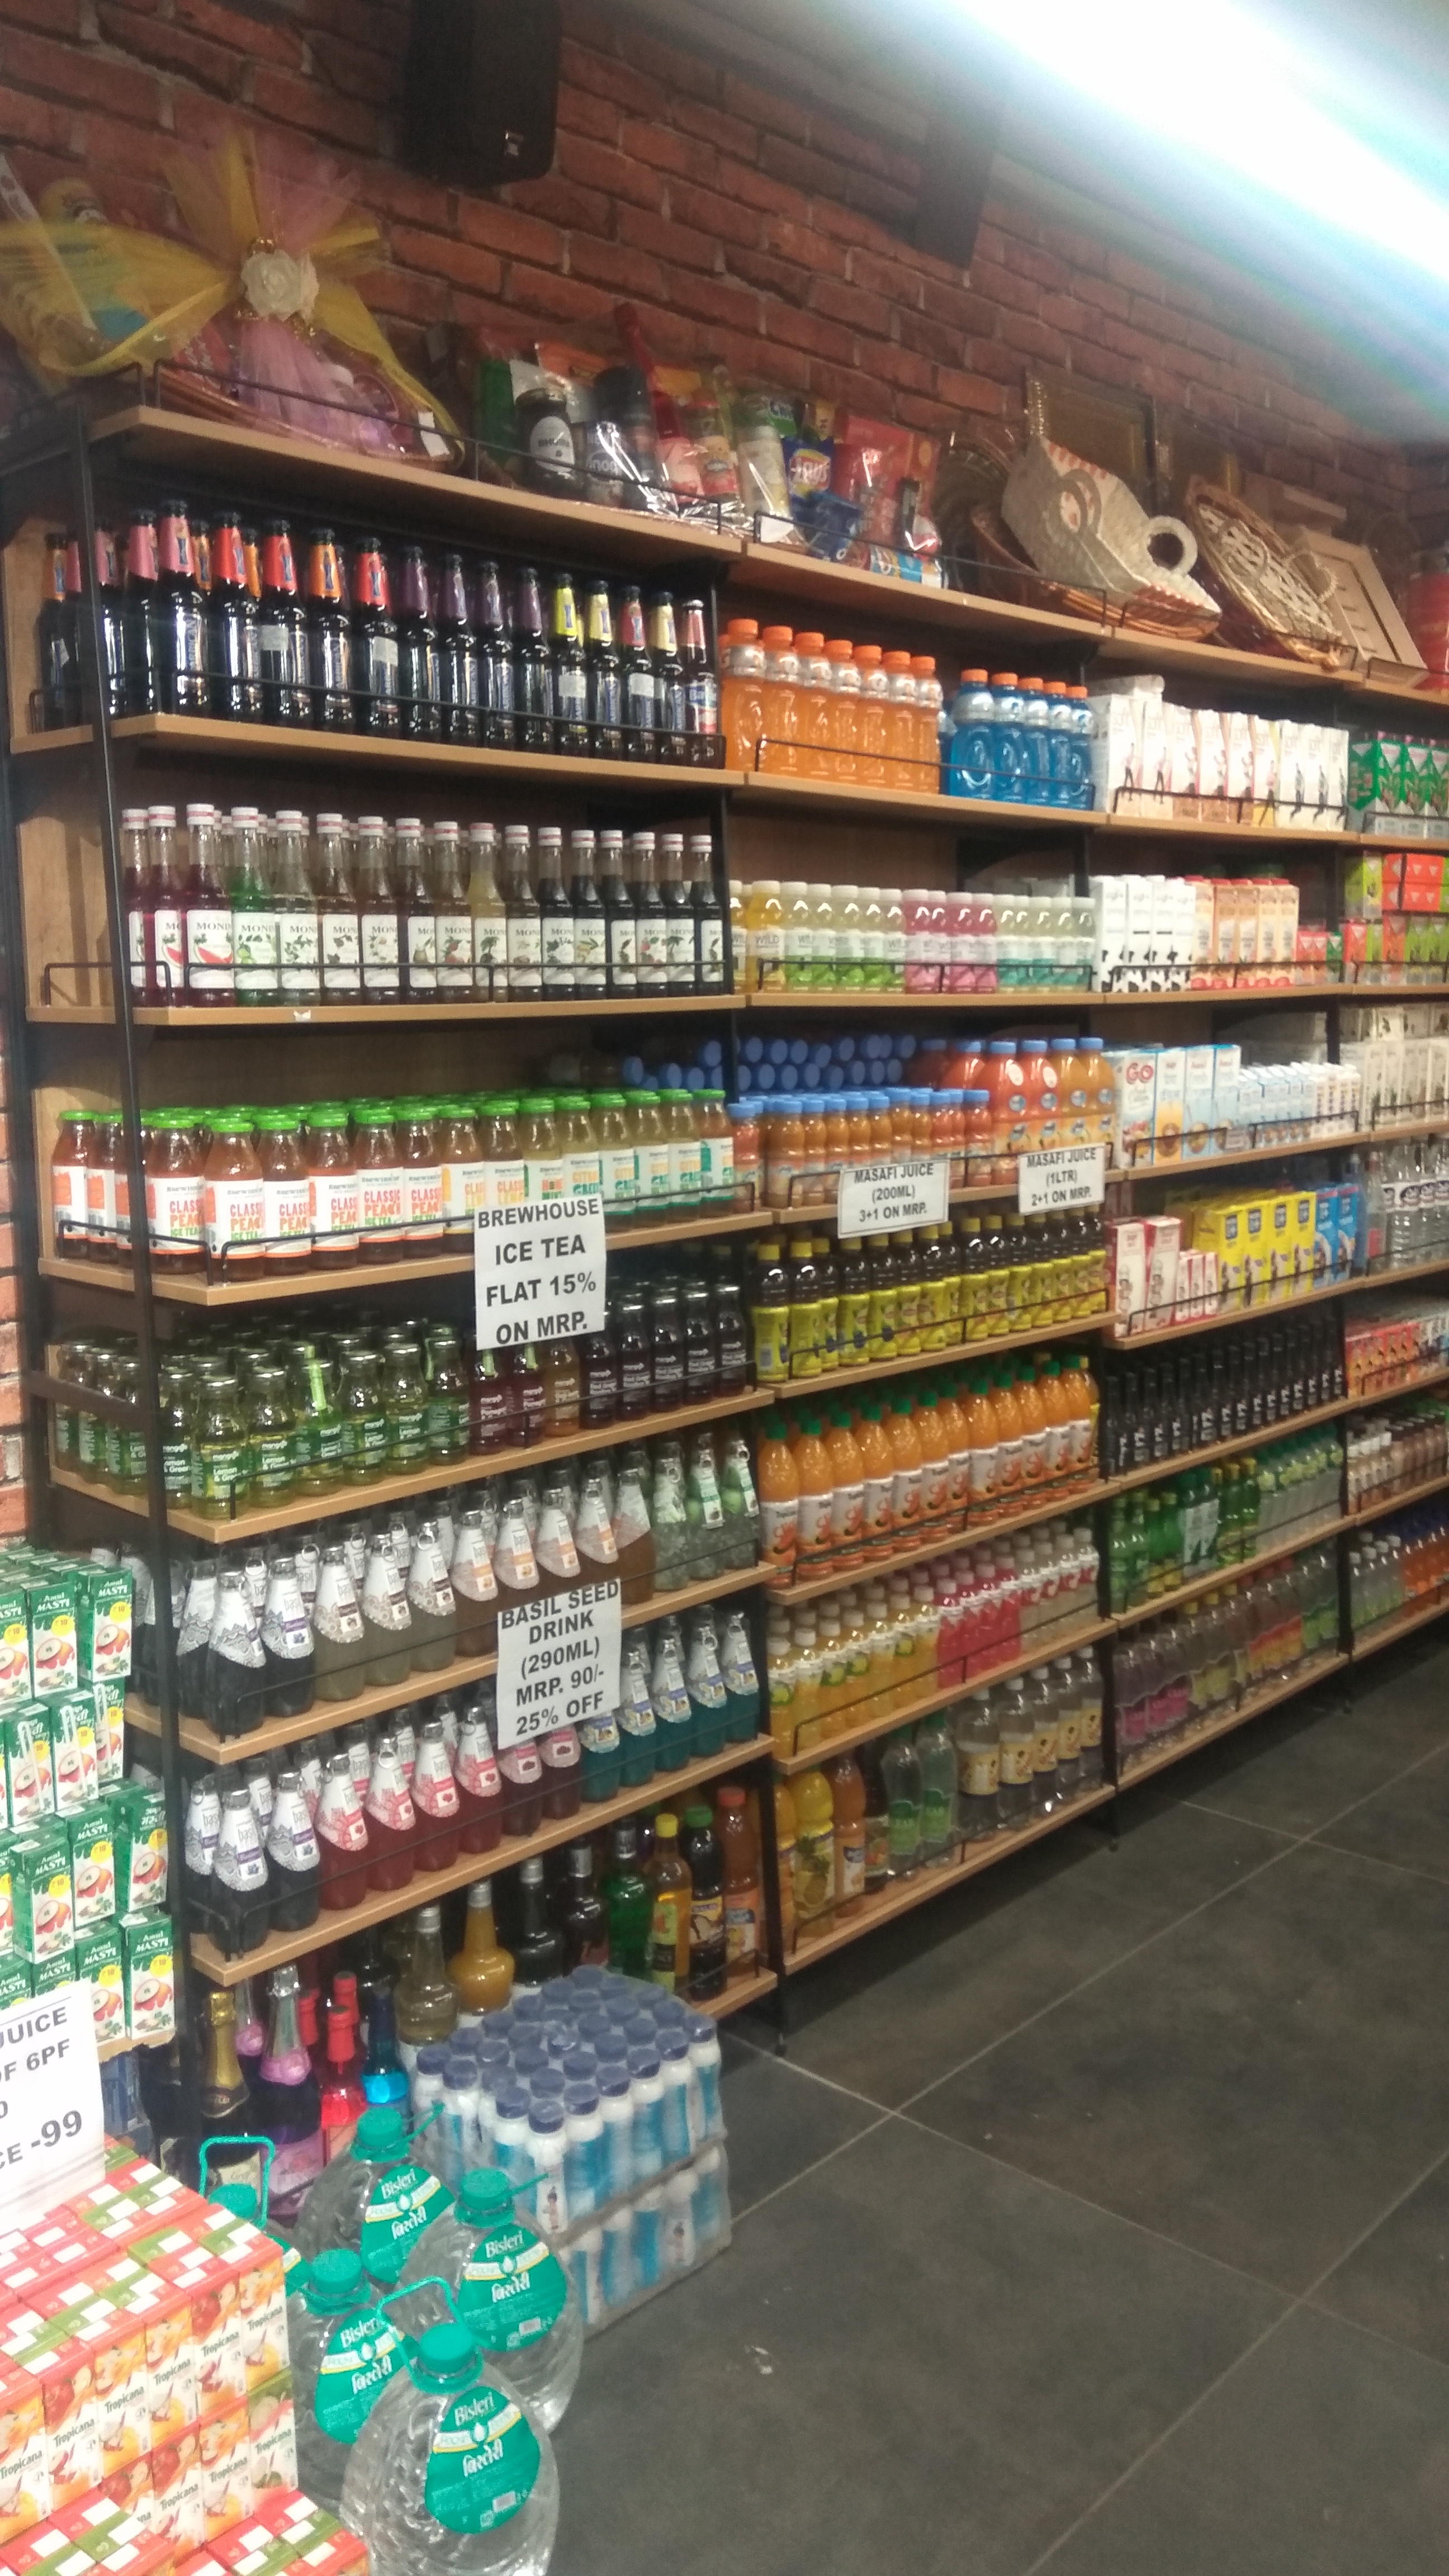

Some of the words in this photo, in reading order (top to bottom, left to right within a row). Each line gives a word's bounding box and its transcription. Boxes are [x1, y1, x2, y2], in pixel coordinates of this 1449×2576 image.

[1126, 1062, 1154, 1084] GO
[1027, 1152, 1064, 1168] MASAFI
[1068, 1148, 1096, 1163] JUICE
[855, 1167, 897, 1183] MASAFI
[900, 1163, 933, 1178] JUICE
[1046, 1169, 1078, 1187] (1LTR)
[331, 1197, 358, 1211] CLASS
[411, 1188, 440, 1201] CLASS
[872, 1187, 916, 1203] (200ML)
[1031, 1193, 1048, 1206] 2+1
[1052, 1189, 1067, 1202] ON
[1069, 1186, 1091, 1200] MRP.
[169, 1199, 203, 1214] CLASS
[230, 1202, 263, 1217] CLASS
[280, 1202, 307, 1216] CLASS
[479, 1199, 599, 1228] BREWHOUSE
[860, 1208, 879, 1222] 3+1
[883, 1205, 899, 1218] ON
[903, 1202, 926, 1216] MRP.
[495, 1241, 532, 1265] ICE
[541, 1234, 586, 1258] TEA
[486, 1278, 541, 1307] FLAT
[550, 1271, 596, 1296] 15%
[496, 1320, 528, 1344] ON
[537, 1311, 588, 1338] MRP.
[98, 1585, 128, 1597] MASTI
[104, 1579, 122, 1588] Amul
[36, 1599, 70, 1612] MASTI
[44, 1592, 64, 1602] Amul
[502, 1596, 561, 1629] BASIL
[569, 1580, 619, 1609] SEED
[0, 1607, 21, 1618] ASTI
[529, 1610, 594, 1645] DRINK
[522, 1636, 600, 1680] (290ML)
[517, 1678, 564, 1706] MRP.
[571, 1664, 604, 1689] 90/-
[517, 1706, 558, 1736] 25%
[566, 1691, 604, 1718] OFF
[83, 1818, 103, 1829] Amul
[203, 1813, 217, 1826] bas
[77, 1824, 108, 1841] MASTI
[238, 1827, 253, 1842] bas
[35, 1857, 65, 1876] MASTI
[41, 1851, 60, 1864] Amul
[136, 1938, 168, 1953] MASTI
[143, 1931, 163, 1942] Amul
[84, 1947, 116, 1966] MASTI
[91, 1942, 111, 1954] Amul
[39, 1963, 70, 1982] MASTI
[45, 1957, 65, 1970] Amul
[0, 1980, 26, 1994] ASTI
[0, 2061, 17, 2082] F
[26, 2039, 70, 2071] 6PF
[0, 2143, 23, 2170] E
[31, 2110, 82, 2148] -99
[381, 2168, 417, 2200] Bisleri
[485, 2230, 524, 2258] Bisleri
[247, 2306, 282, 2331] Tropicana
[201, 2332, 239, 2357] Tropicana
[154, 2357, 191, 2386] Tropicana
[105, 2386, 144, 2413] Tropicana
[454, 2392, 495, 2426] Bisleri
[54, 2418, 94, 2448] Tropicana
[255, 2428, 292, 2454] Tropicana
[0, 2449, 42, 2479] Tropicana
[209, 2456, 247, 2483] Tropicana
[160, 2483, 199, 2511] Tropicana
